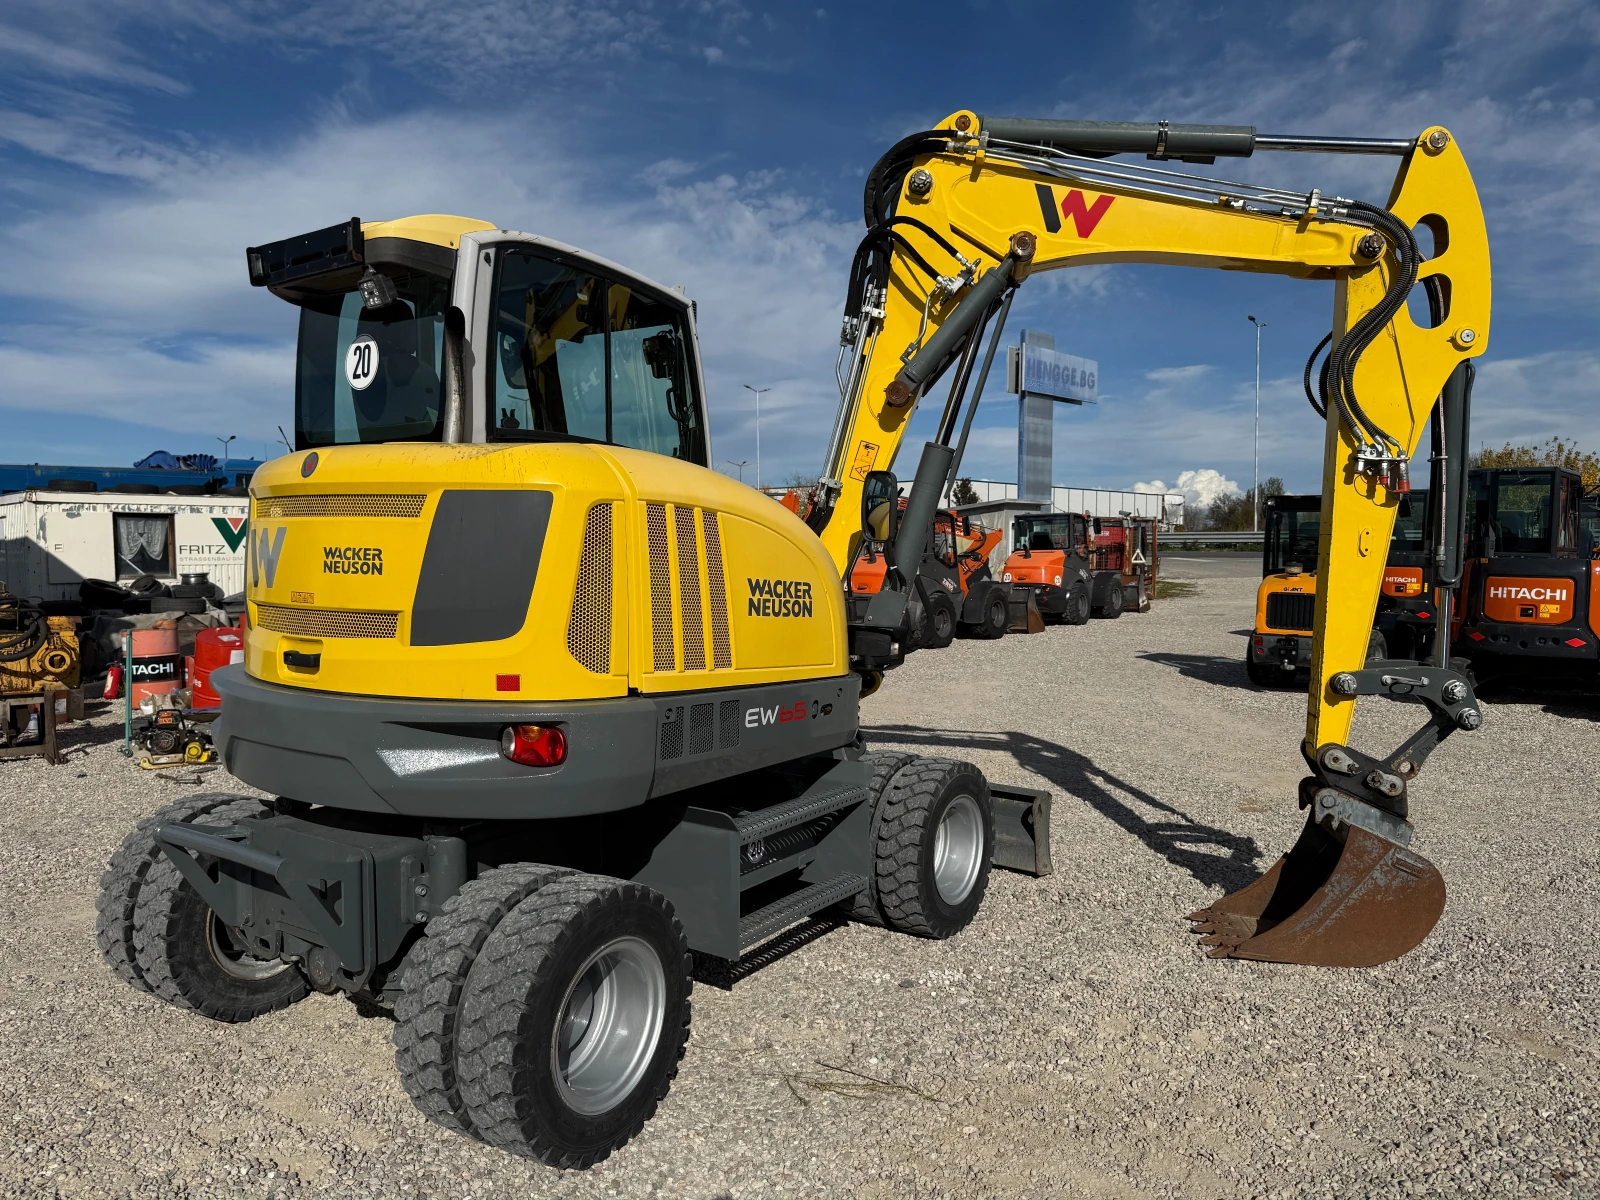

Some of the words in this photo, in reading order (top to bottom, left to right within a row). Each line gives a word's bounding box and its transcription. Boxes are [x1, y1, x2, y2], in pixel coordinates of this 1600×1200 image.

[352, 343, 371, 380] 20
[178, 544, 226, 555] FRITZ
[323, 546, 383, 561] WACKER
[323, 560, 383, 576] NEUSON
[747, 578, 813, 600] WACKER
[1489, 586, 1567, 601] HITACHI
[747, 598, 813, 618] NEUSON
[131, 662, 174, 675] TACHI
[744, 701, 808, 728] EW65
